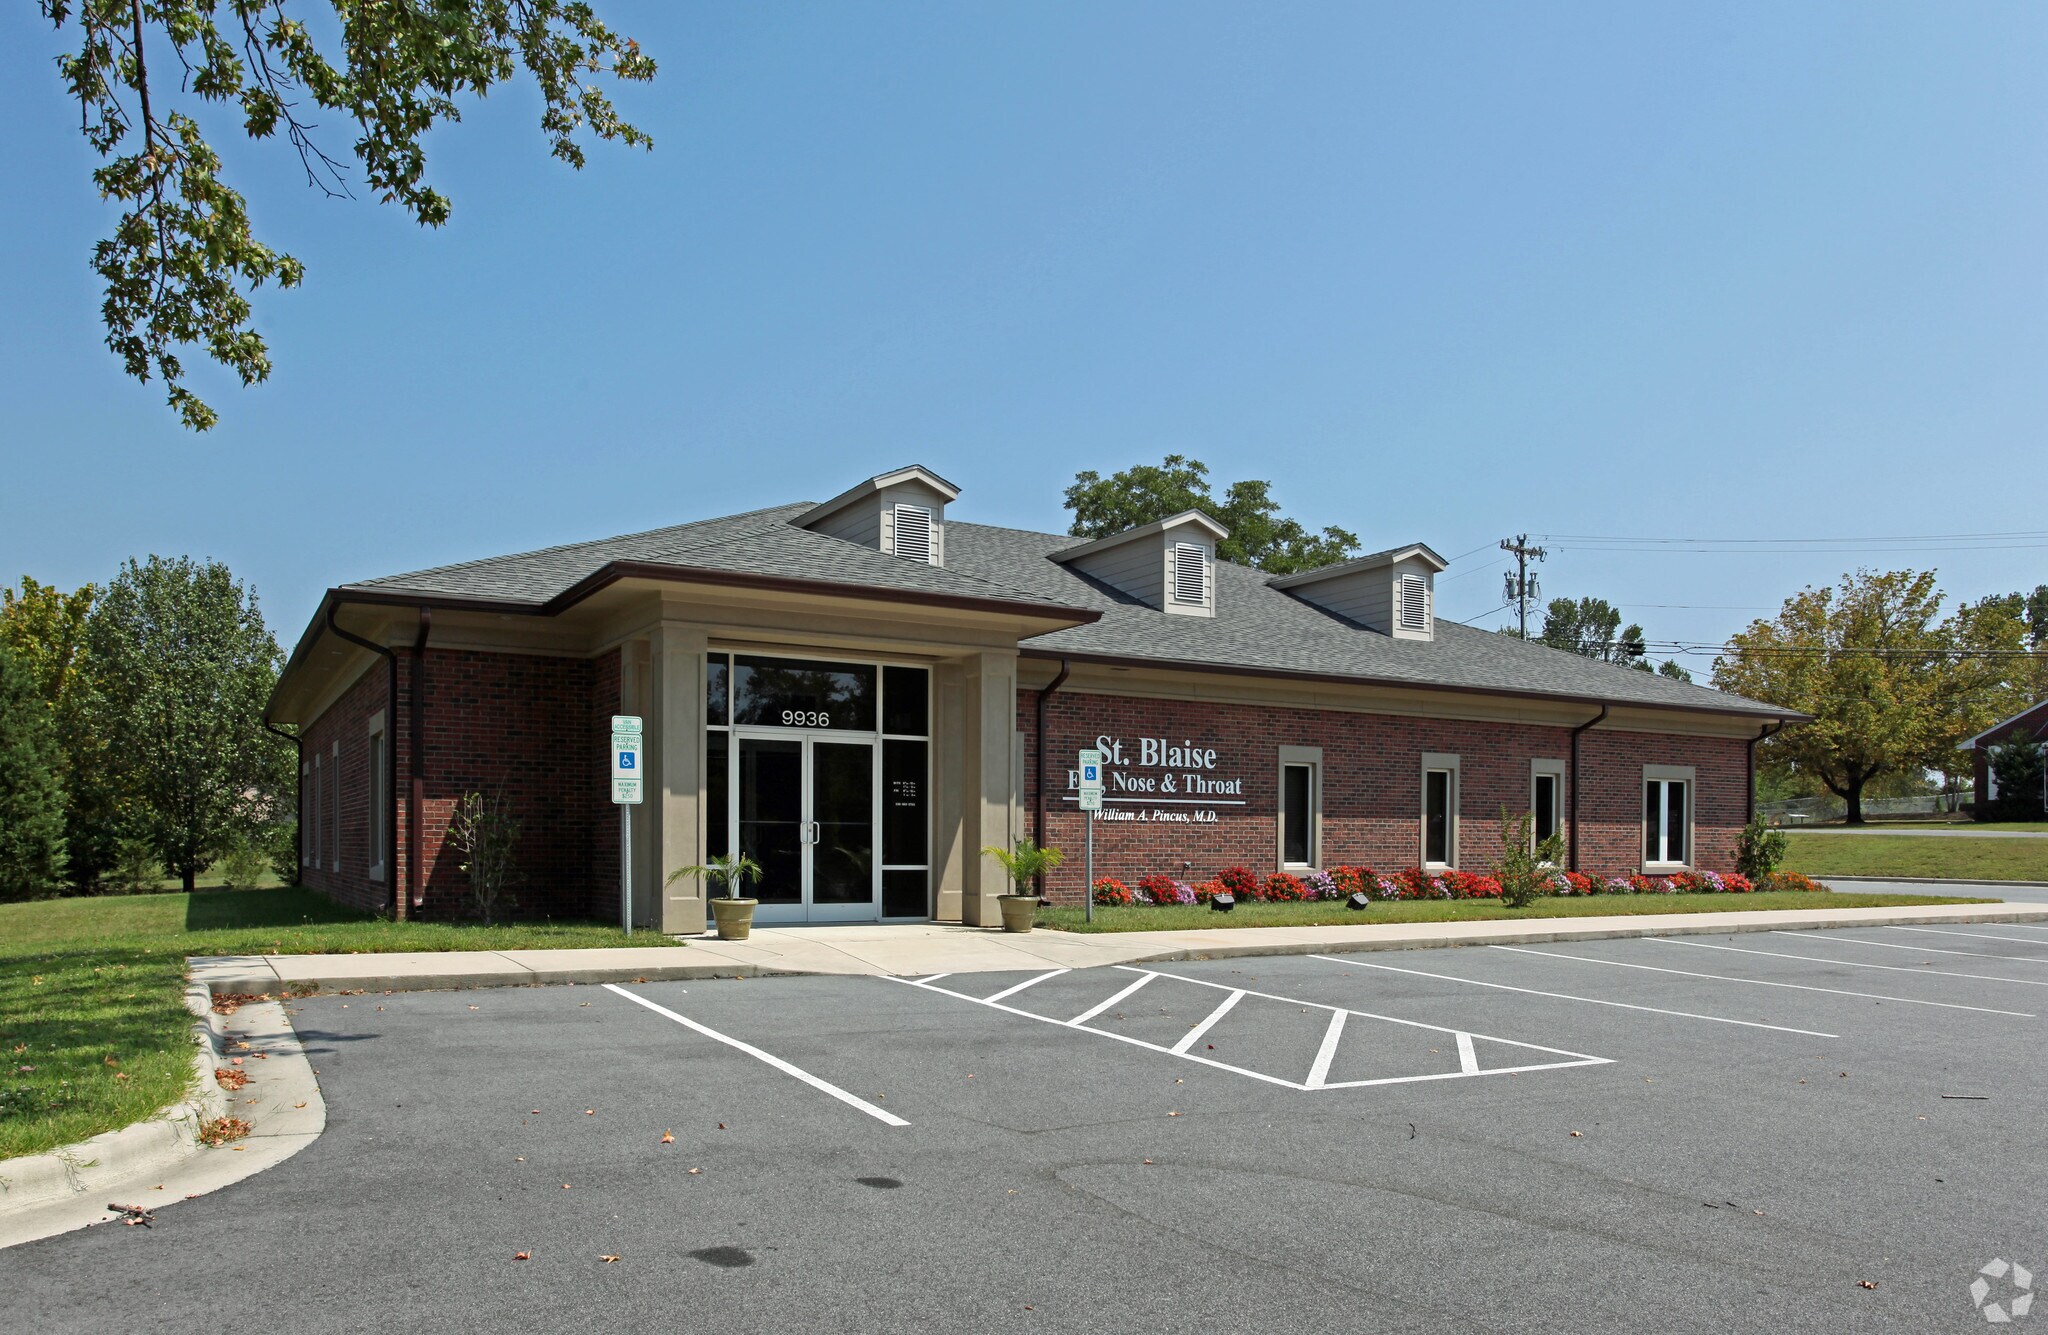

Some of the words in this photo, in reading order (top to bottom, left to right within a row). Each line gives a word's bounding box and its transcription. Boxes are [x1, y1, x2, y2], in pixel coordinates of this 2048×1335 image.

[782, 710, 830, 727] 9936
[1096, 735, 1130, 766] St.
[1138, 737, 1217, 769] Blaise
[1112, 771, 1156, 792] Nose
[1160, 773, 1177, 793] &
[1183, 774, 1242, 794] Throat
[1093, 809, 1135, 821] William
[1136, 810, 1149, 821] A.
[1151, 810, 1190, 823] Pincus,
[1192, 811, 1218, 822] M.D.
